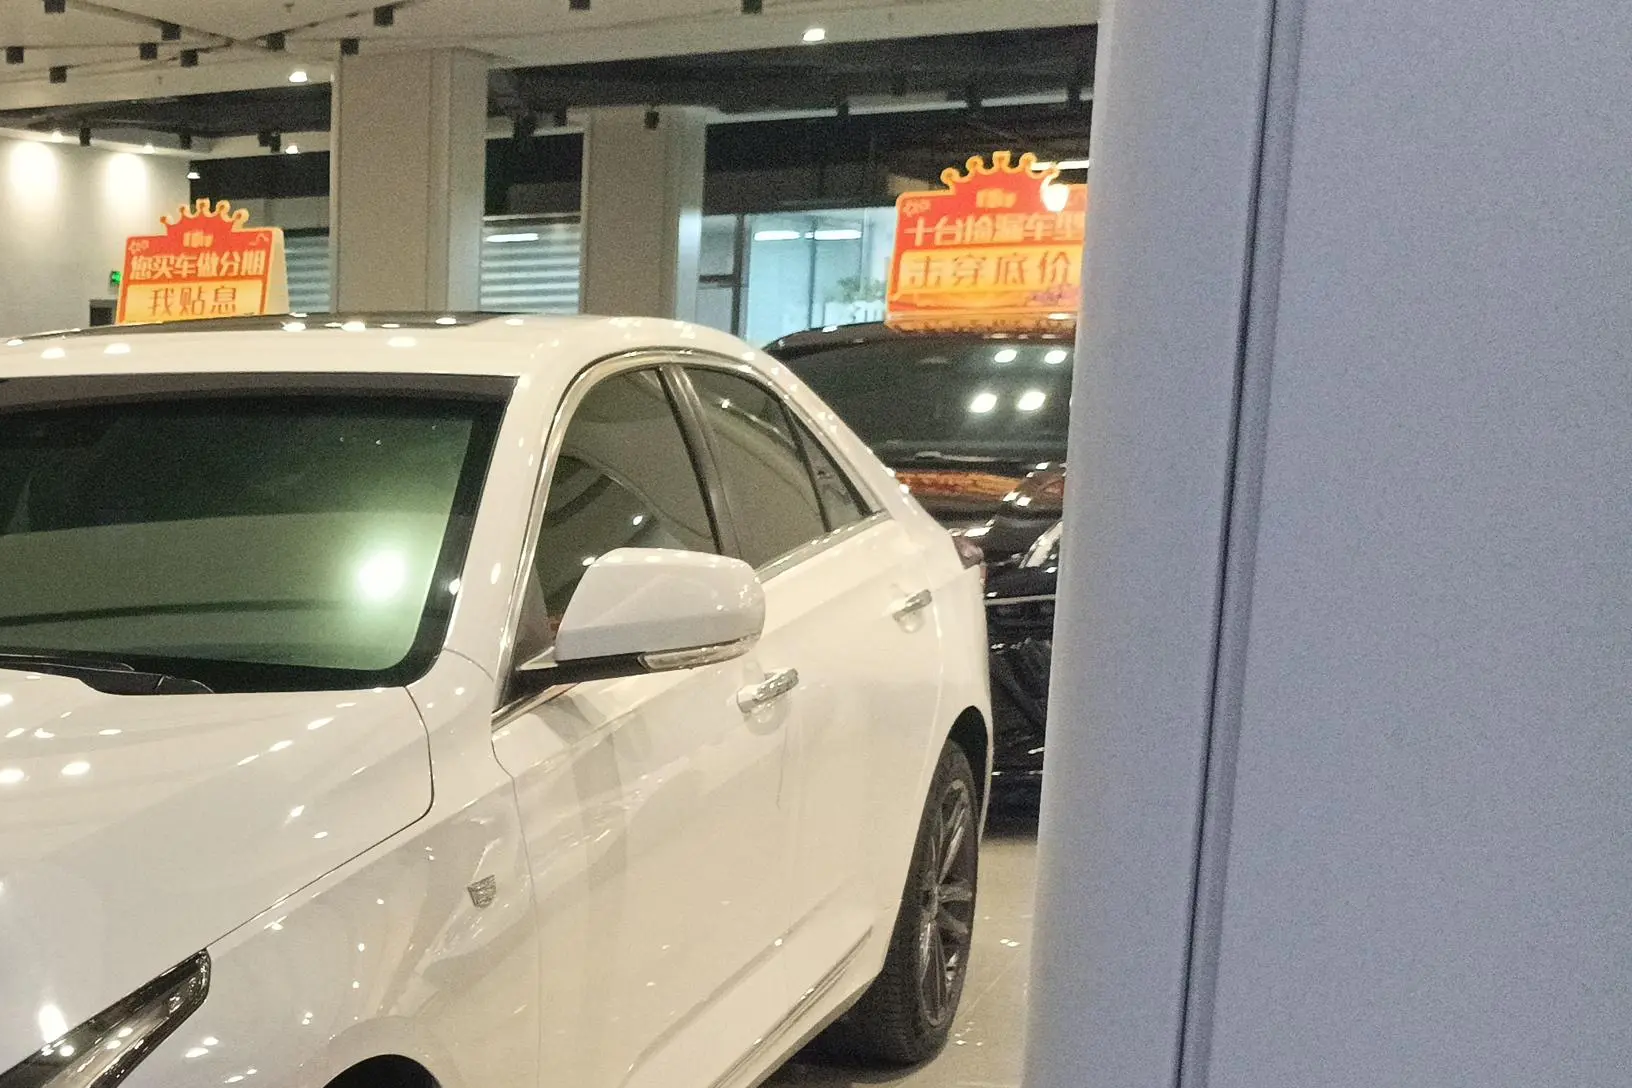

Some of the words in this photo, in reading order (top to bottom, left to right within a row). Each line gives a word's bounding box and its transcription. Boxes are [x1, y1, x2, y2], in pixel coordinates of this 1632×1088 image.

[129, 250, 266, 281] 您买车做分期
[148, 285, 236, 316] 我贴息
